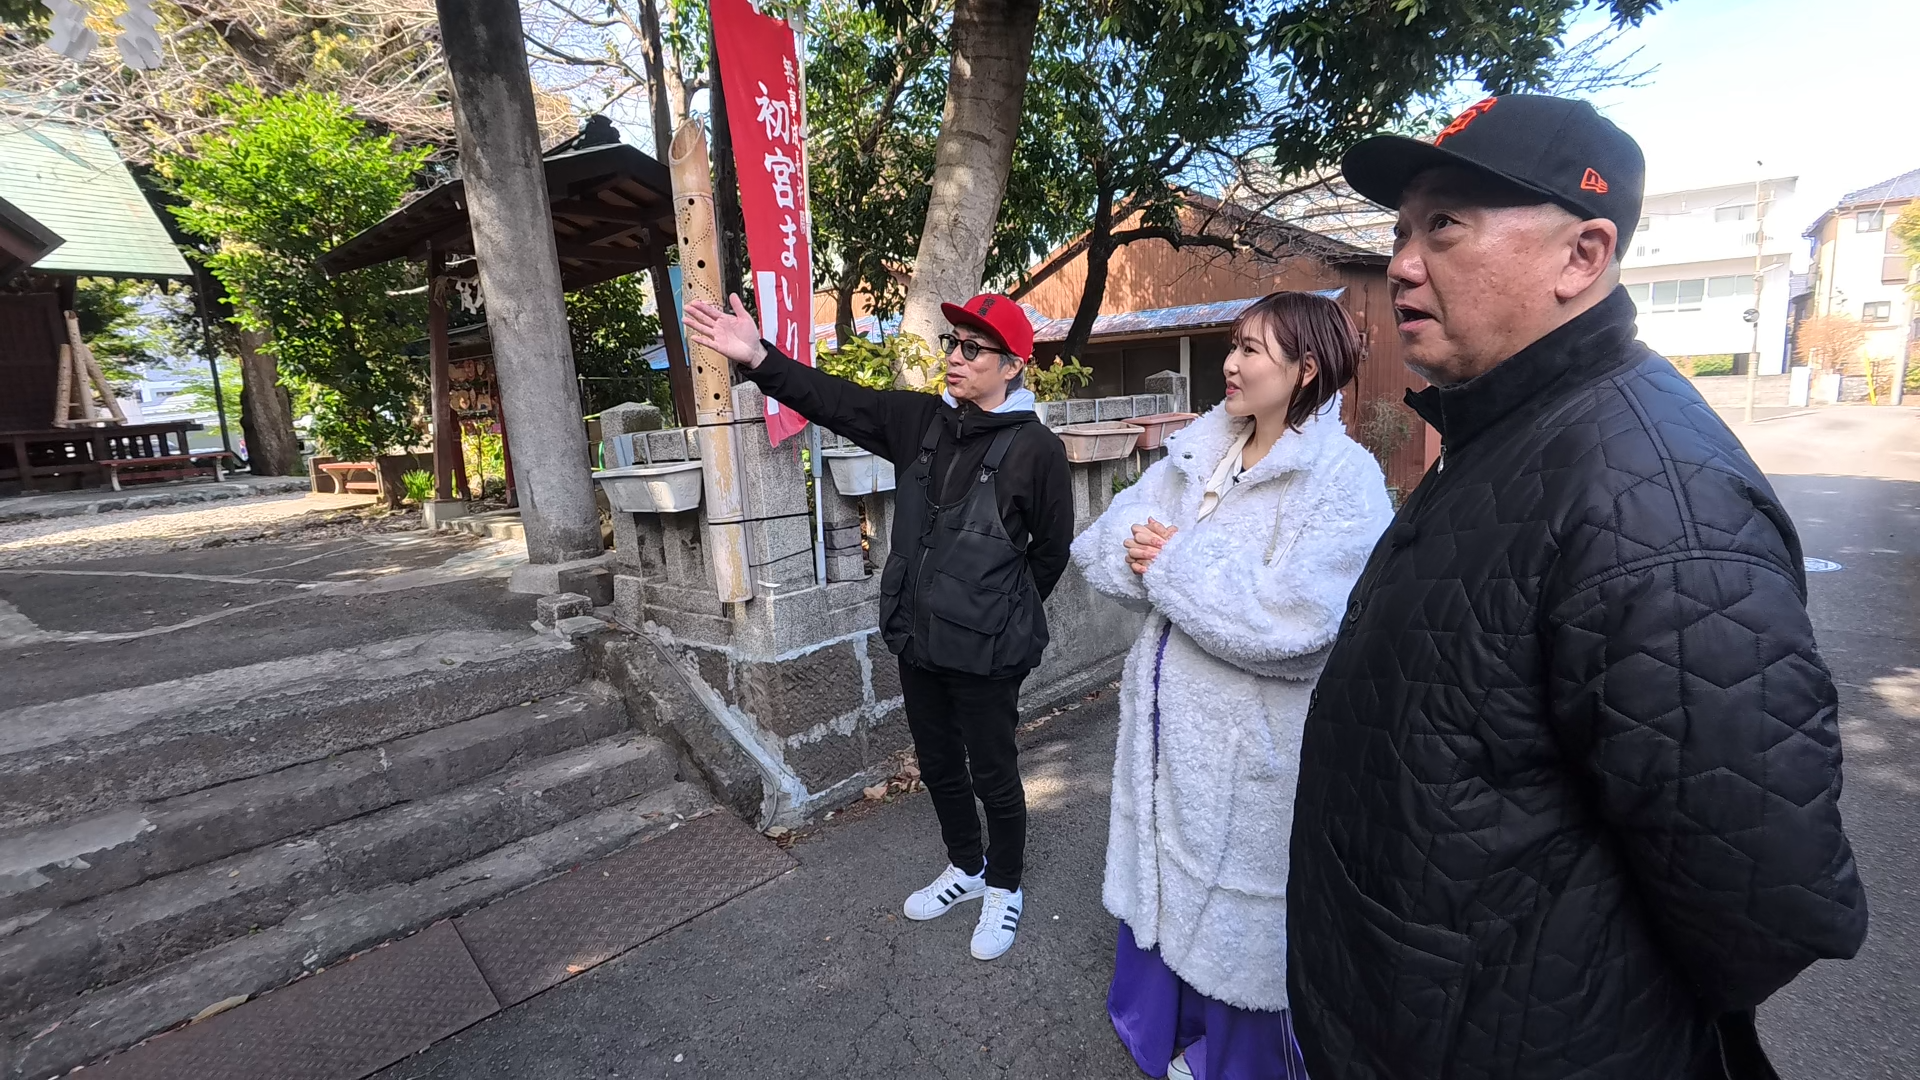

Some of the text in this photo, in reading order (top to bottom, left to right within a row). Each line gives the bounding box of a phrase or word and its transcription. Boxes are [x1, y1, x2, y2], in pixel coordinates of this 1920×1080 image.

[755, 80, 798, 360] 初宮まいり
